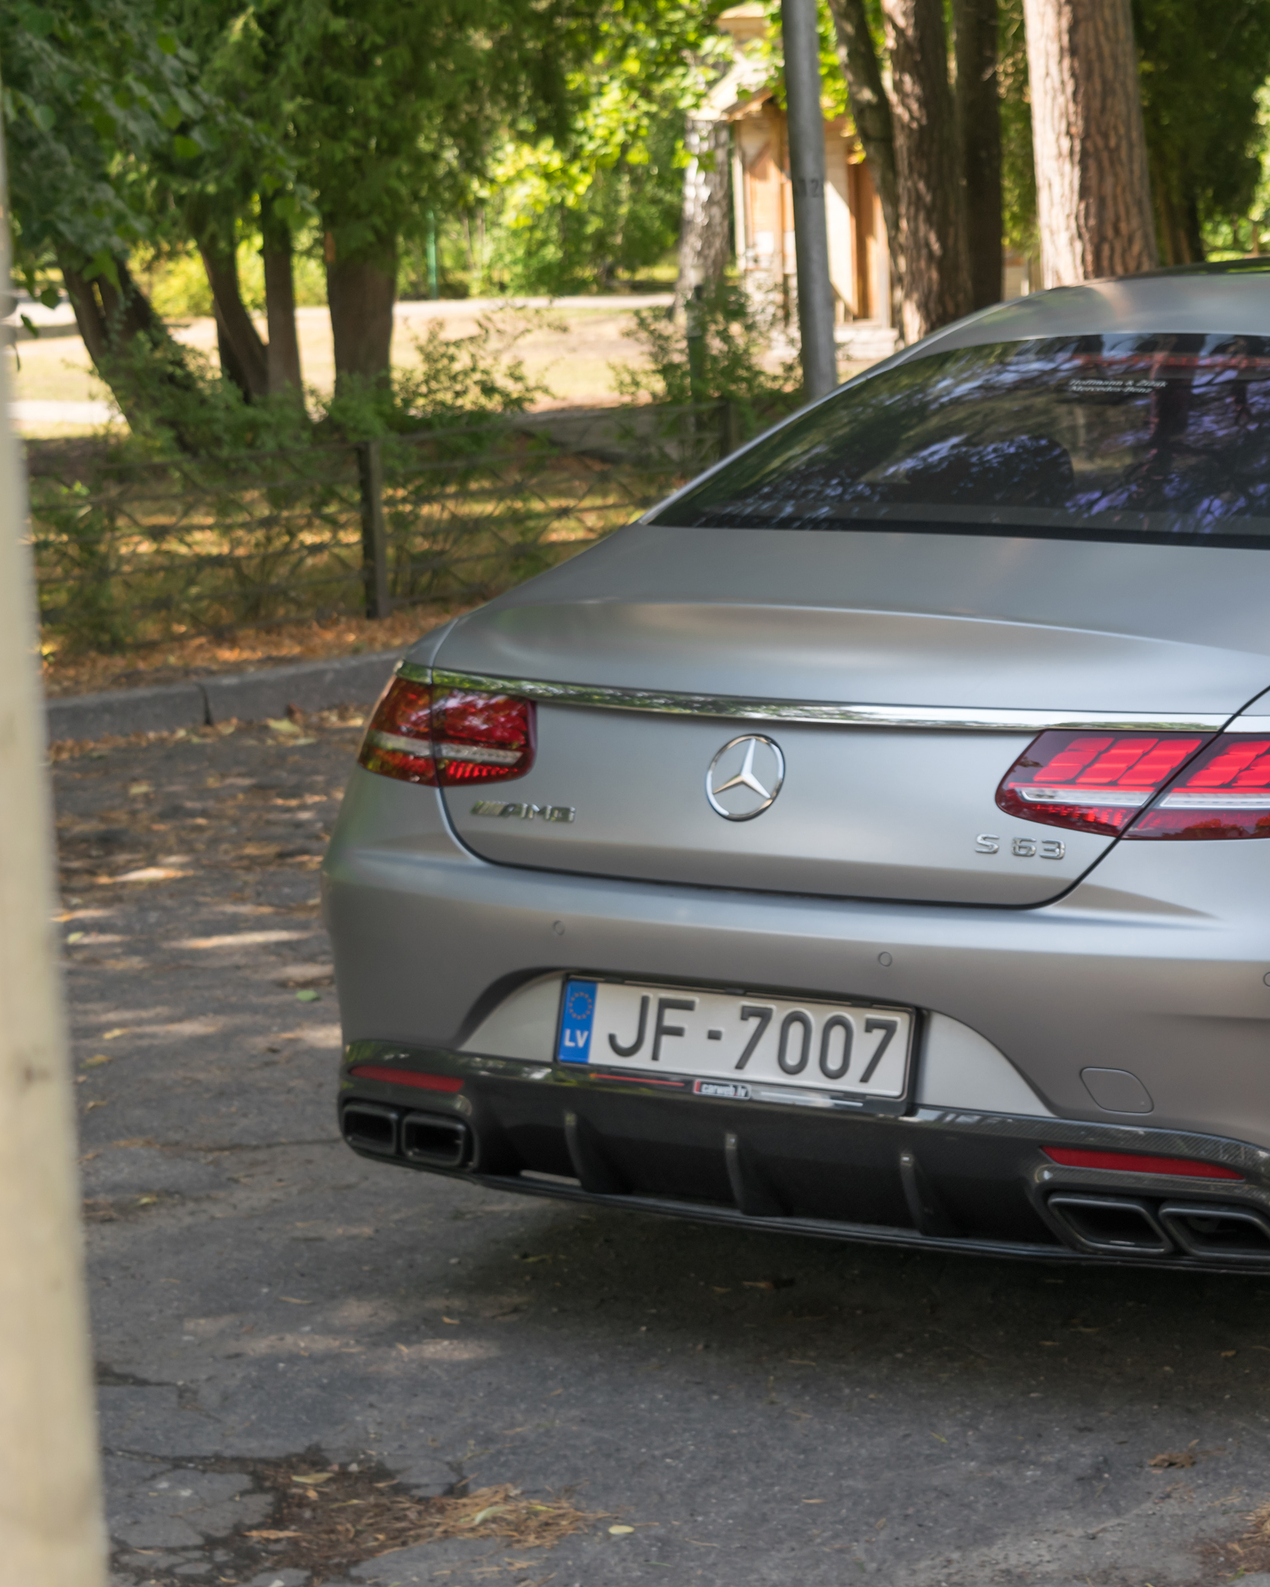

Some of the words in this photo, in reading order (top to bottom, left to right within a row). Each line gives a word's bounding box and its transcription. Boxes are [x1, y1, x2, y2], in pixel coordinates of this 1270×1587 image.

[1070, 386, 1153, 394] Mercedes-Benz
[496, 802, 576, 822] AMG
[975, 834, 999, 854] S
[1011, 836, 1066, 860] 63
[564, 1029, 588, 1048] LV
[701, 1083, 748, 1098] carweb.lv
